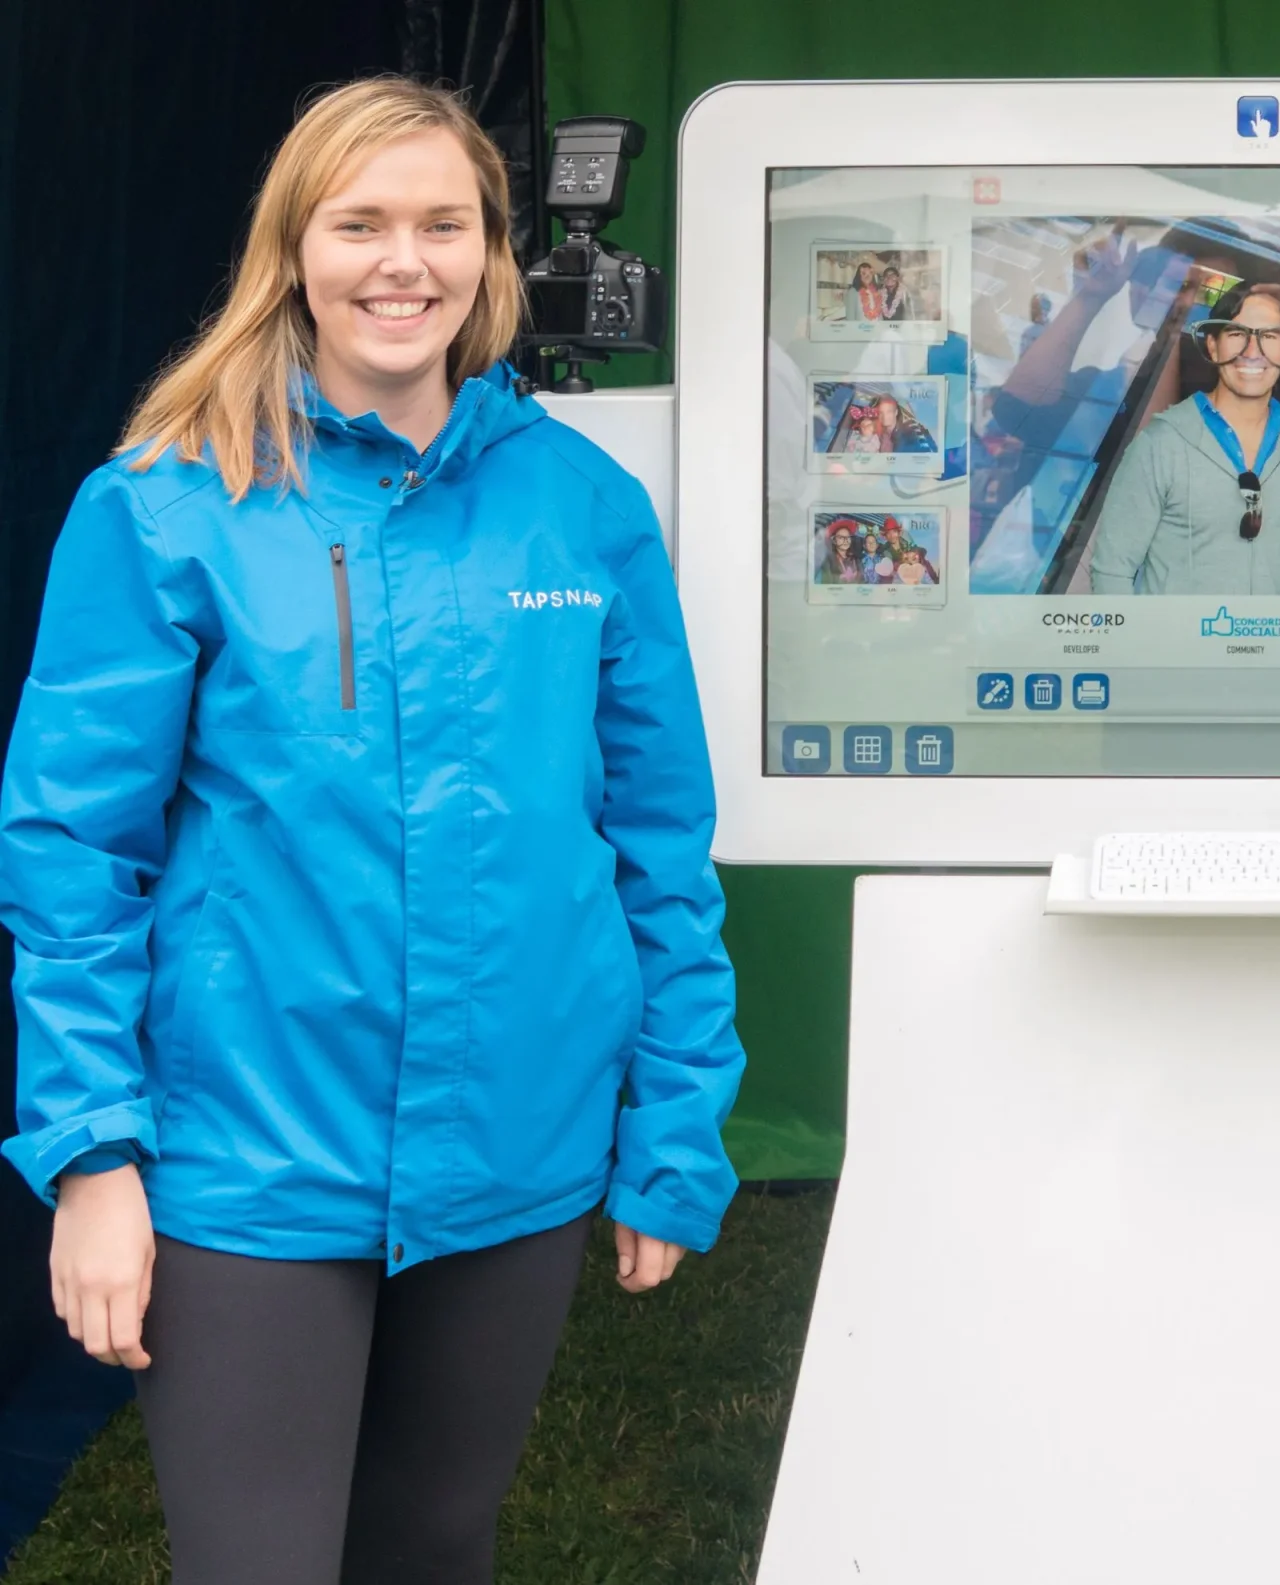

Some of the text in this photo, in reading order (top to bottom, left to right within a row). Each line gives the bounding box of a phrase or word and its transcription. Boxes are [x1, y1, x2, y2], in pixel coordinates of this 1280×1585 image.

[507, 589, 603, 609] TAPSNAP
[1042, 613, 1125, 627] CONCORD
[1063, 645, 1100, 654] DEVELOPER
[1226, 645, 1265, 654] COMMUNITY
